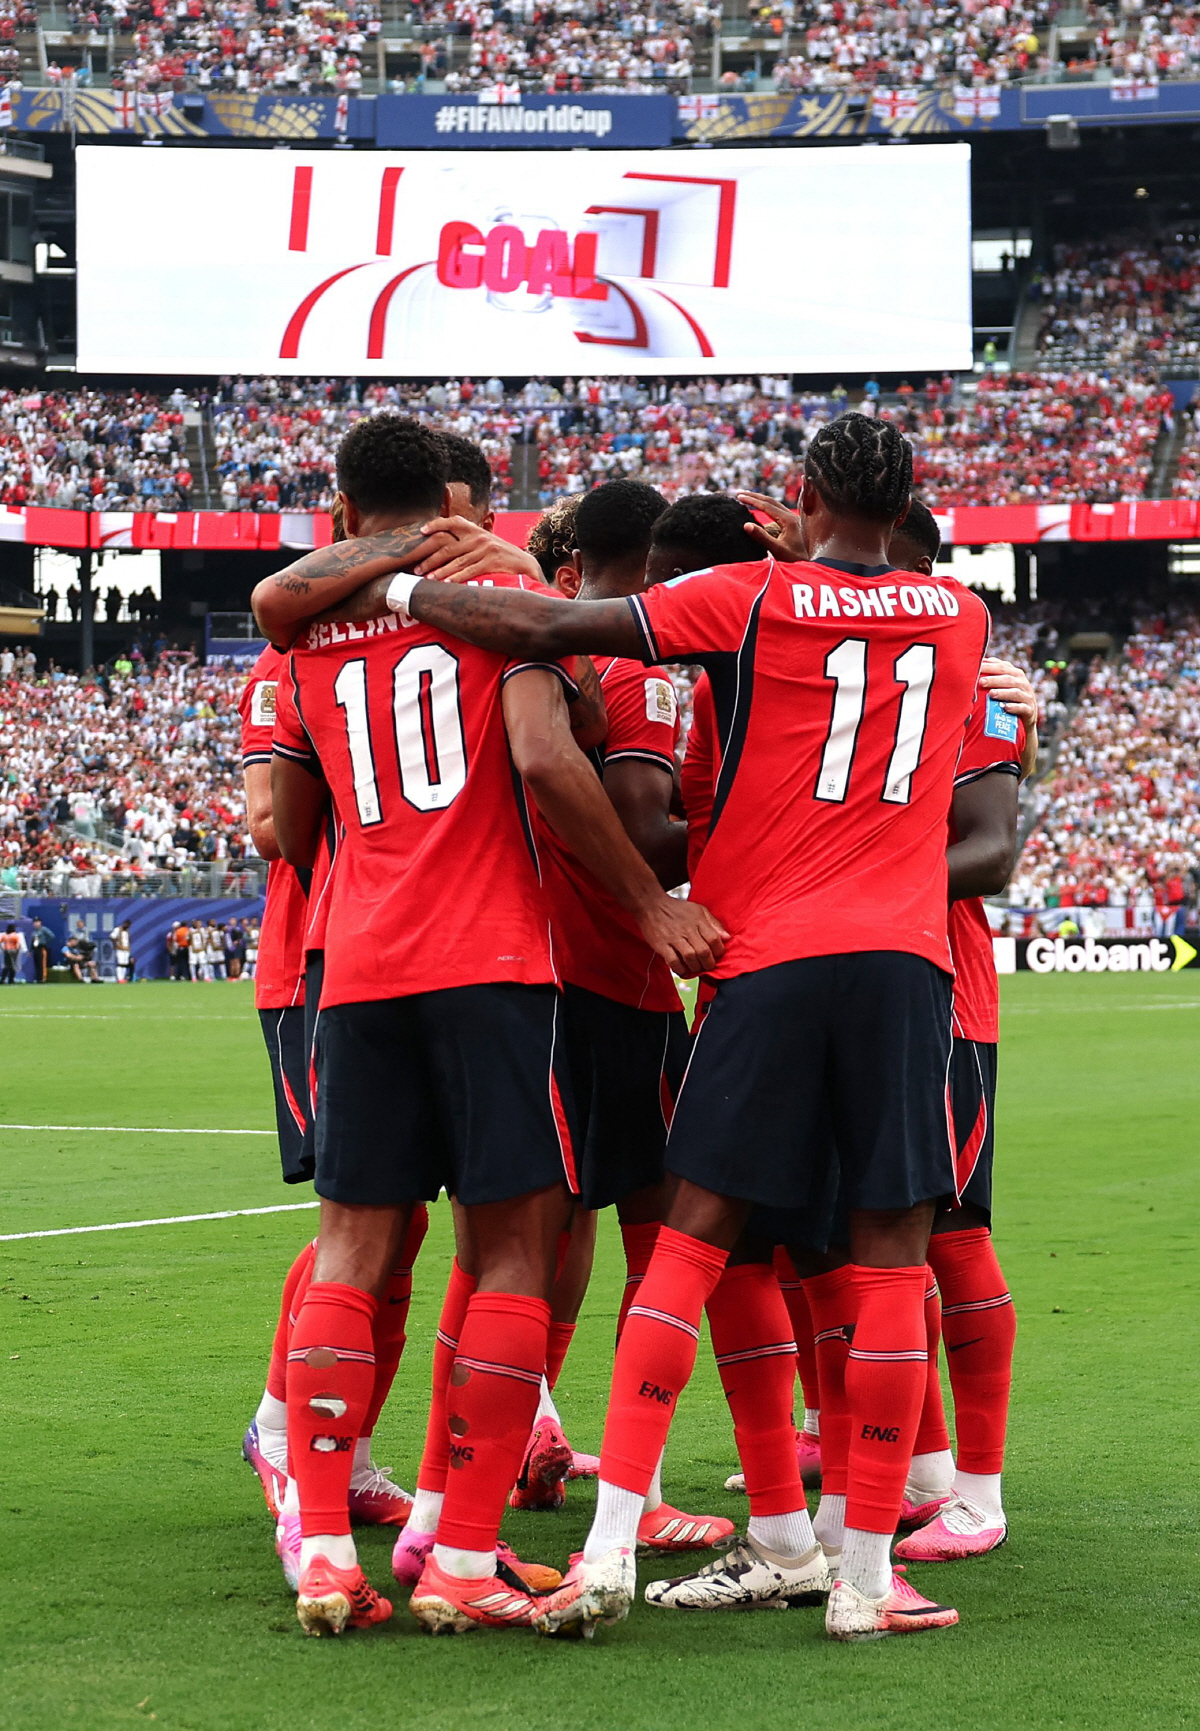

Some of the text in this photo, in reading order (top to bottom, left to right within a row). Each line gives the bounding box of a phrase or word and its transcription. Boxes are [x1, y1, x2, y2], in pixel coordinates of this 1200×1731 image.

[435, 104, 612, 137] #FIFAWorldCup
[436, 220, 609, 301] GOAL
[791, 583, 960, 618] RASHFORD
[334, 641, 468, 827] 10
[813, 635, 937, 804] 11
[1026, 937, 1171, 973] Globant
[638, 1380, 673, 1406] ENG
[861, 1424, 900, 1443] ENG
[450, 1443, 475, 1462] NG
